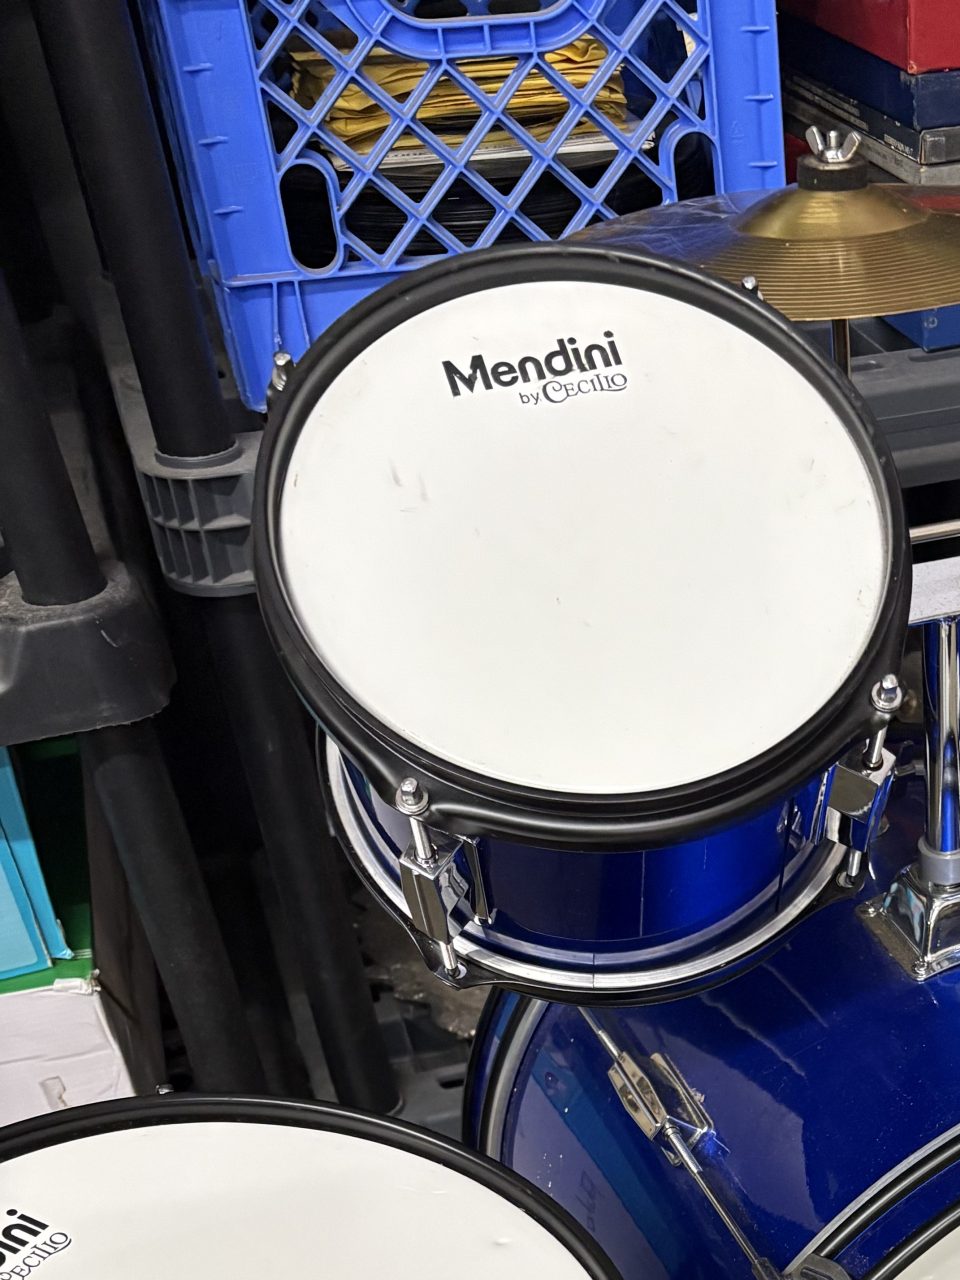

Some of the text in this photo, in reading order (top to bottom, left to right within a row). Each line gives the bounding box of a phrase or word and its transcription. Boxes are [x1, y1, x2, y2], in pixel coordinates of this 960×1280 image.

[441, 329, 623, 397] Mendini
[519, 391, 541, 405] by
[0, 1208, 50, 1267] ini
